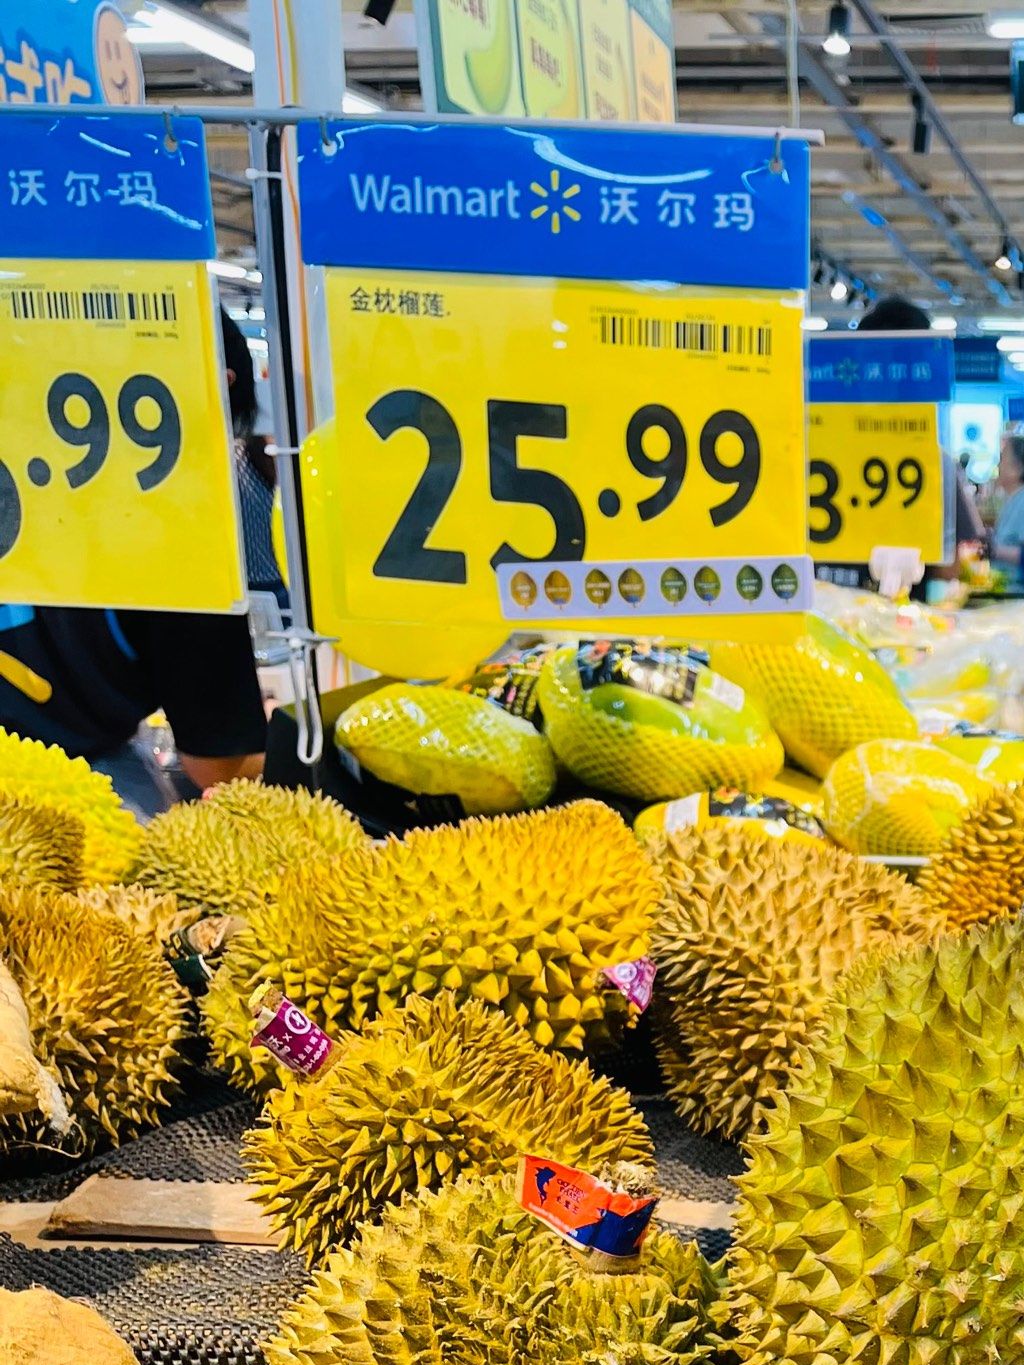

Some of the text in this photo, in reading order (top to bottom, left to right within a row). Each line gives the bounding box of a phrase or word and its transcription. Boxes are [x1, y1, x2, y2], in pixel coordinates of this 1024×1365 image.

[8, 169, 157, 207] 沃尔玛
[350, 173, 521, 219] Walmart
[600, 186, 755, 231] 沃尔玛
[366, 388, 762, 585] 25.99
